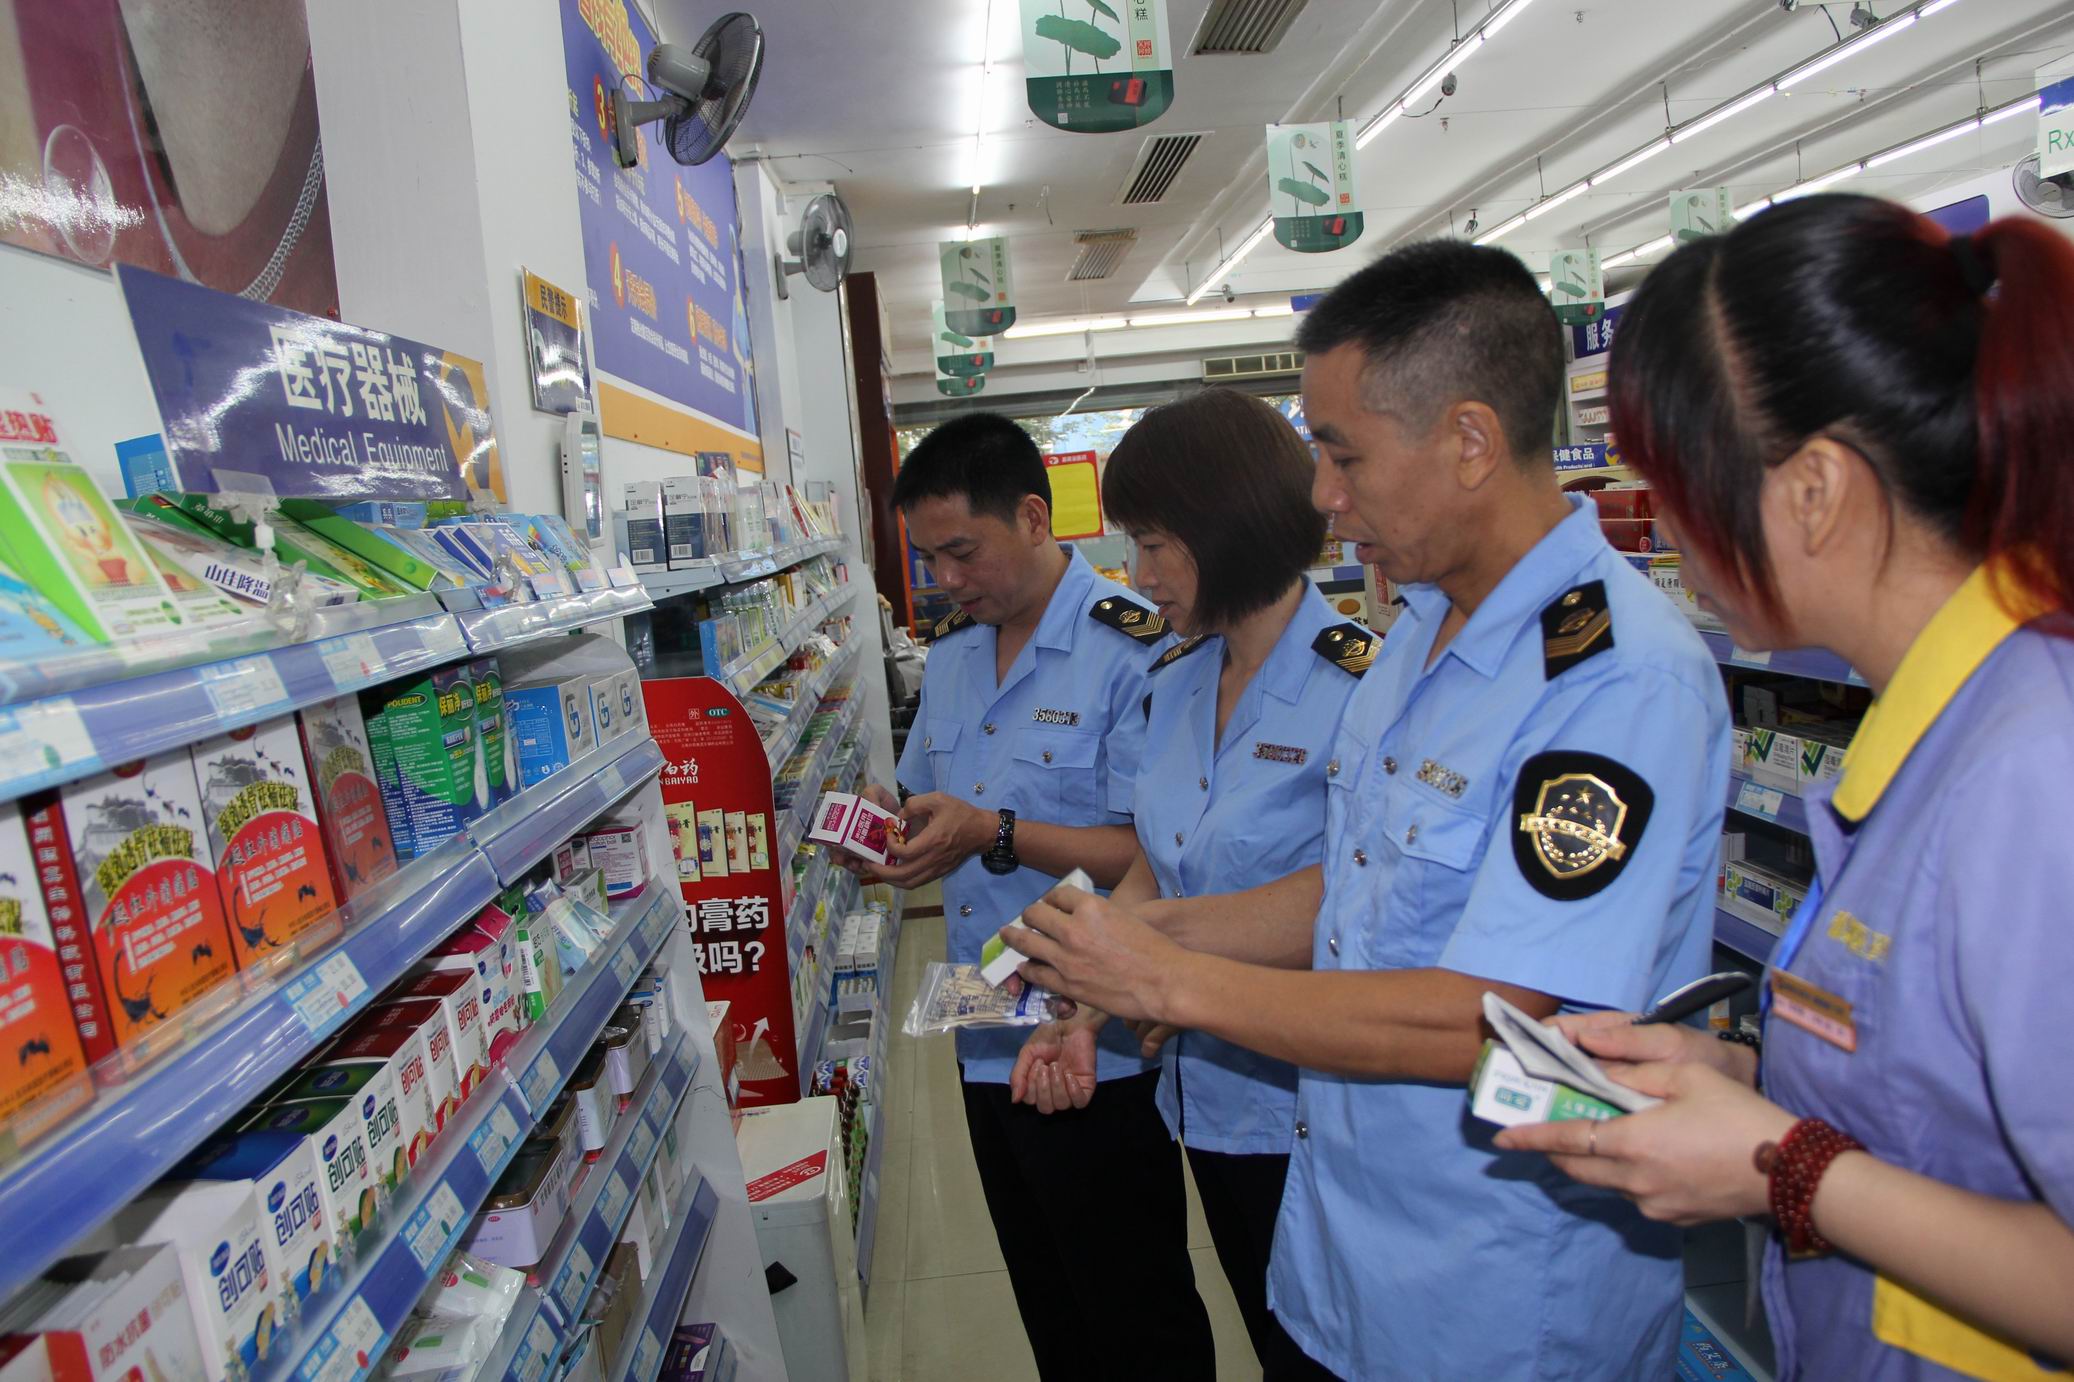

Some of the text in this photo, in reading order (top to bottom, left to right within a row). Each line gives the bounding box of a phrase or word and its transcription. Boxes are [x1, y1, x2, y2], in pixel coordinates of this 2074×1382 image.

[597, 82, 607, 129] 3
[614, 252, 623, 298] 4
[269, 326, 427, 426] 医疗器械
[275, 422, 449, 471] Medical Equipment
[204, 564, 271, 600] 山佳降温
[708, 708, 728, 717] OTC
[658, 758, 699, 776] 白药
[457, 995, 479, 1031] 创可贴
[430, 1024, 450, 1063] 创可贴
[401, 1054, 425, 1095] 创可贴
[367, 1096, 399, 1149] 创可贴
[328, 1135, 366, 1193] 创可贴
[274, 1180, 320, 1247] 创可贴
[217, 1237, 266, 1313] 创可贴
